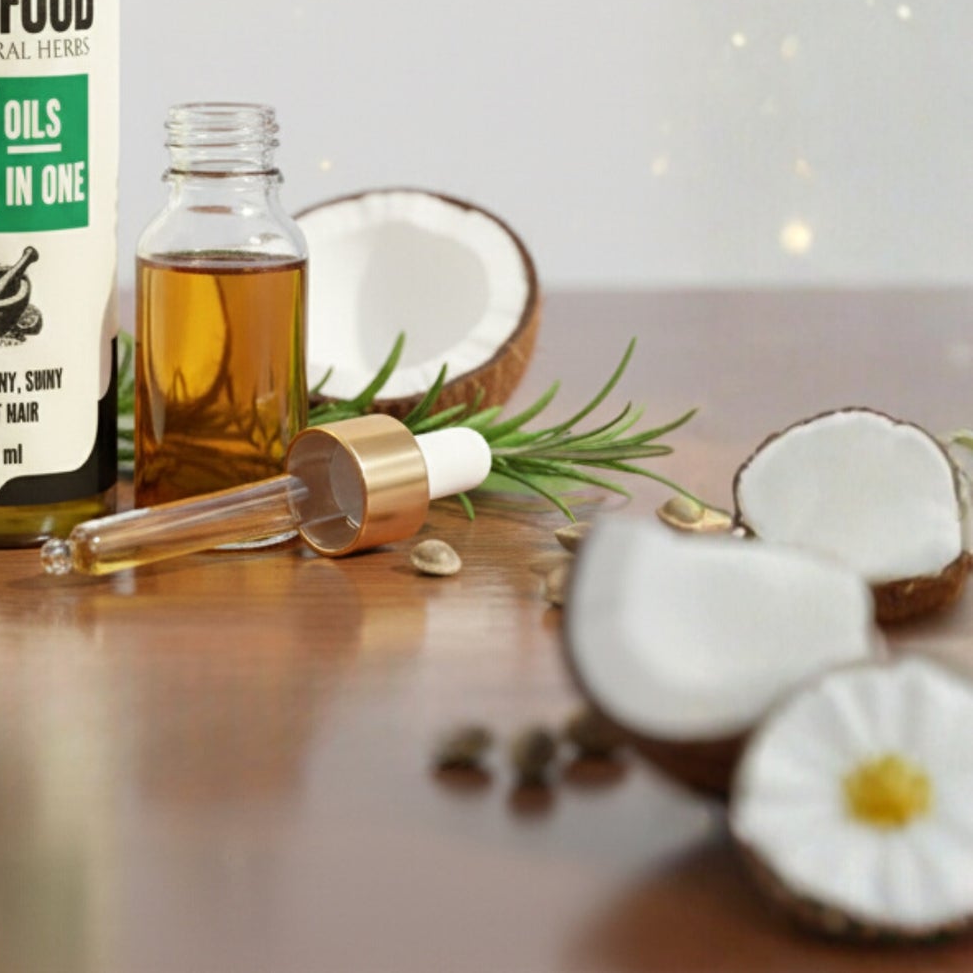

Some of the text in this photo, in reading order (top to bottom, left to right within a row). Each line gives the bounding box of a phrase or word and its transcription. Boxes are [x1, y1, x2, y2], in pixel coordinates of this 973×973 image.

[38, 37, 90, 59] HERBS
[4, 98, 62, 140] OILS
[6, 161, 85, 206] IN ONE
[3, 444, 23, 465] ml
